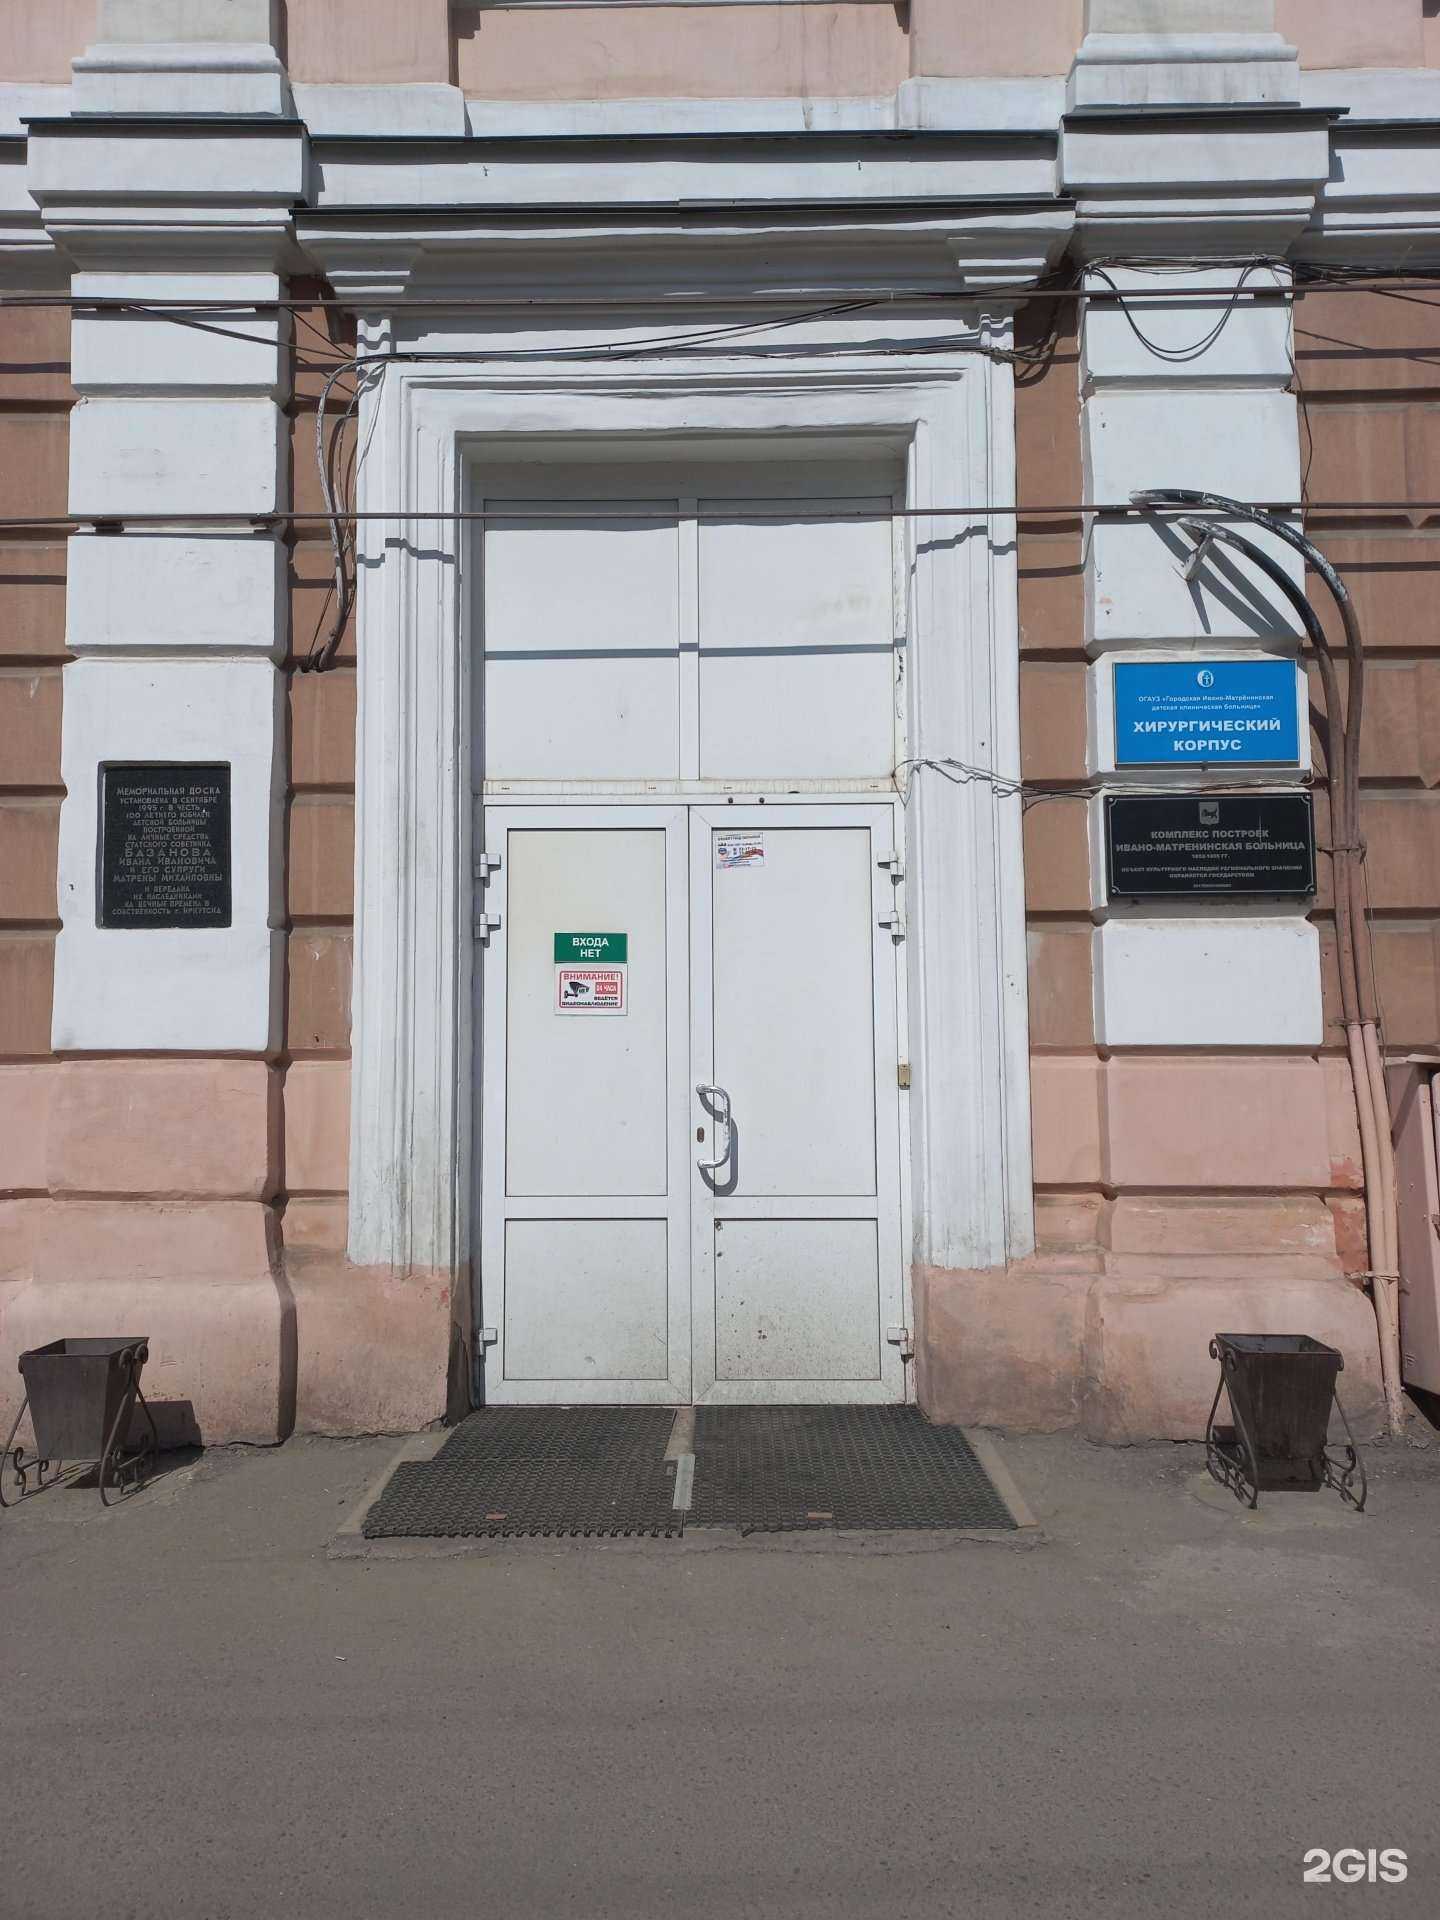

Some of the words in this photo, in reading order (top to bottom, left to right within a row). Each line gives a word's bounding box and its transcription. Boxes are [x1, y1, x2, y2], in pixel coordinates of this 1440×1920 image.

[1134, 718, 1281, 733] ХИРУРГИЧЕСКИЙ
[1173, 740, 1242, 751] КОРПУС
[116, 787, 185, 796] МЕМОРИАЛЬНАЯ
[189, 787, 221, 796] ДОСКА
[1151, 830, 1209, 838] КОМПЛЕКС
[1212, 829, 1269, 838] ПОСТРОЕК
[1115, 842, 1242, 852] ИВАНО-МАТРЕНИНСКАЯ
[1246, 842, 1305, 850] БОЛЬНИЦА
[125, 848, 211, 857] БАЗАНОВА
[572, 938, 609, 948] ВХОДА
[580, 949, 601, 958] НЕТ
